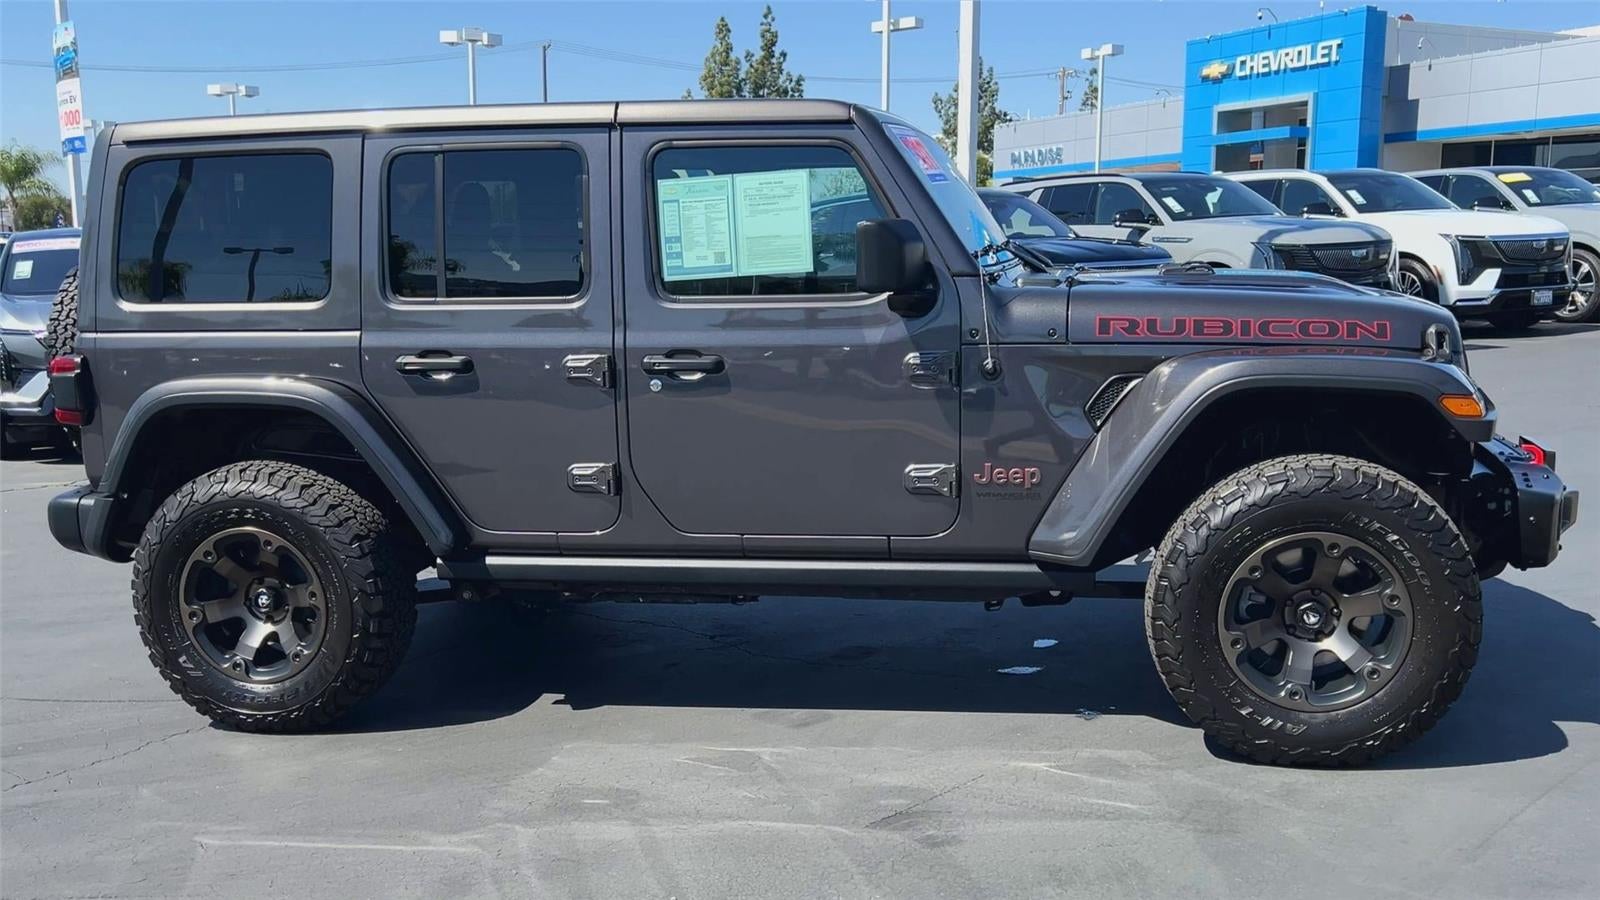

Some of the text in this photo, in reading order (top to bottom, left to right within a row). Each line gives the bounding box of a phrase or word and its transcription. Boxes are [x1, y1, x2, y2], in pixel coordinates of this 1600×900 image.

[1235, 40, 1342, 78] CHEVROLET
[1009, 145, 1064, 167] PARADISE
[1096, 316, 1391, 341] RUBICON
[973, 463, 1042, 489] Jeep
